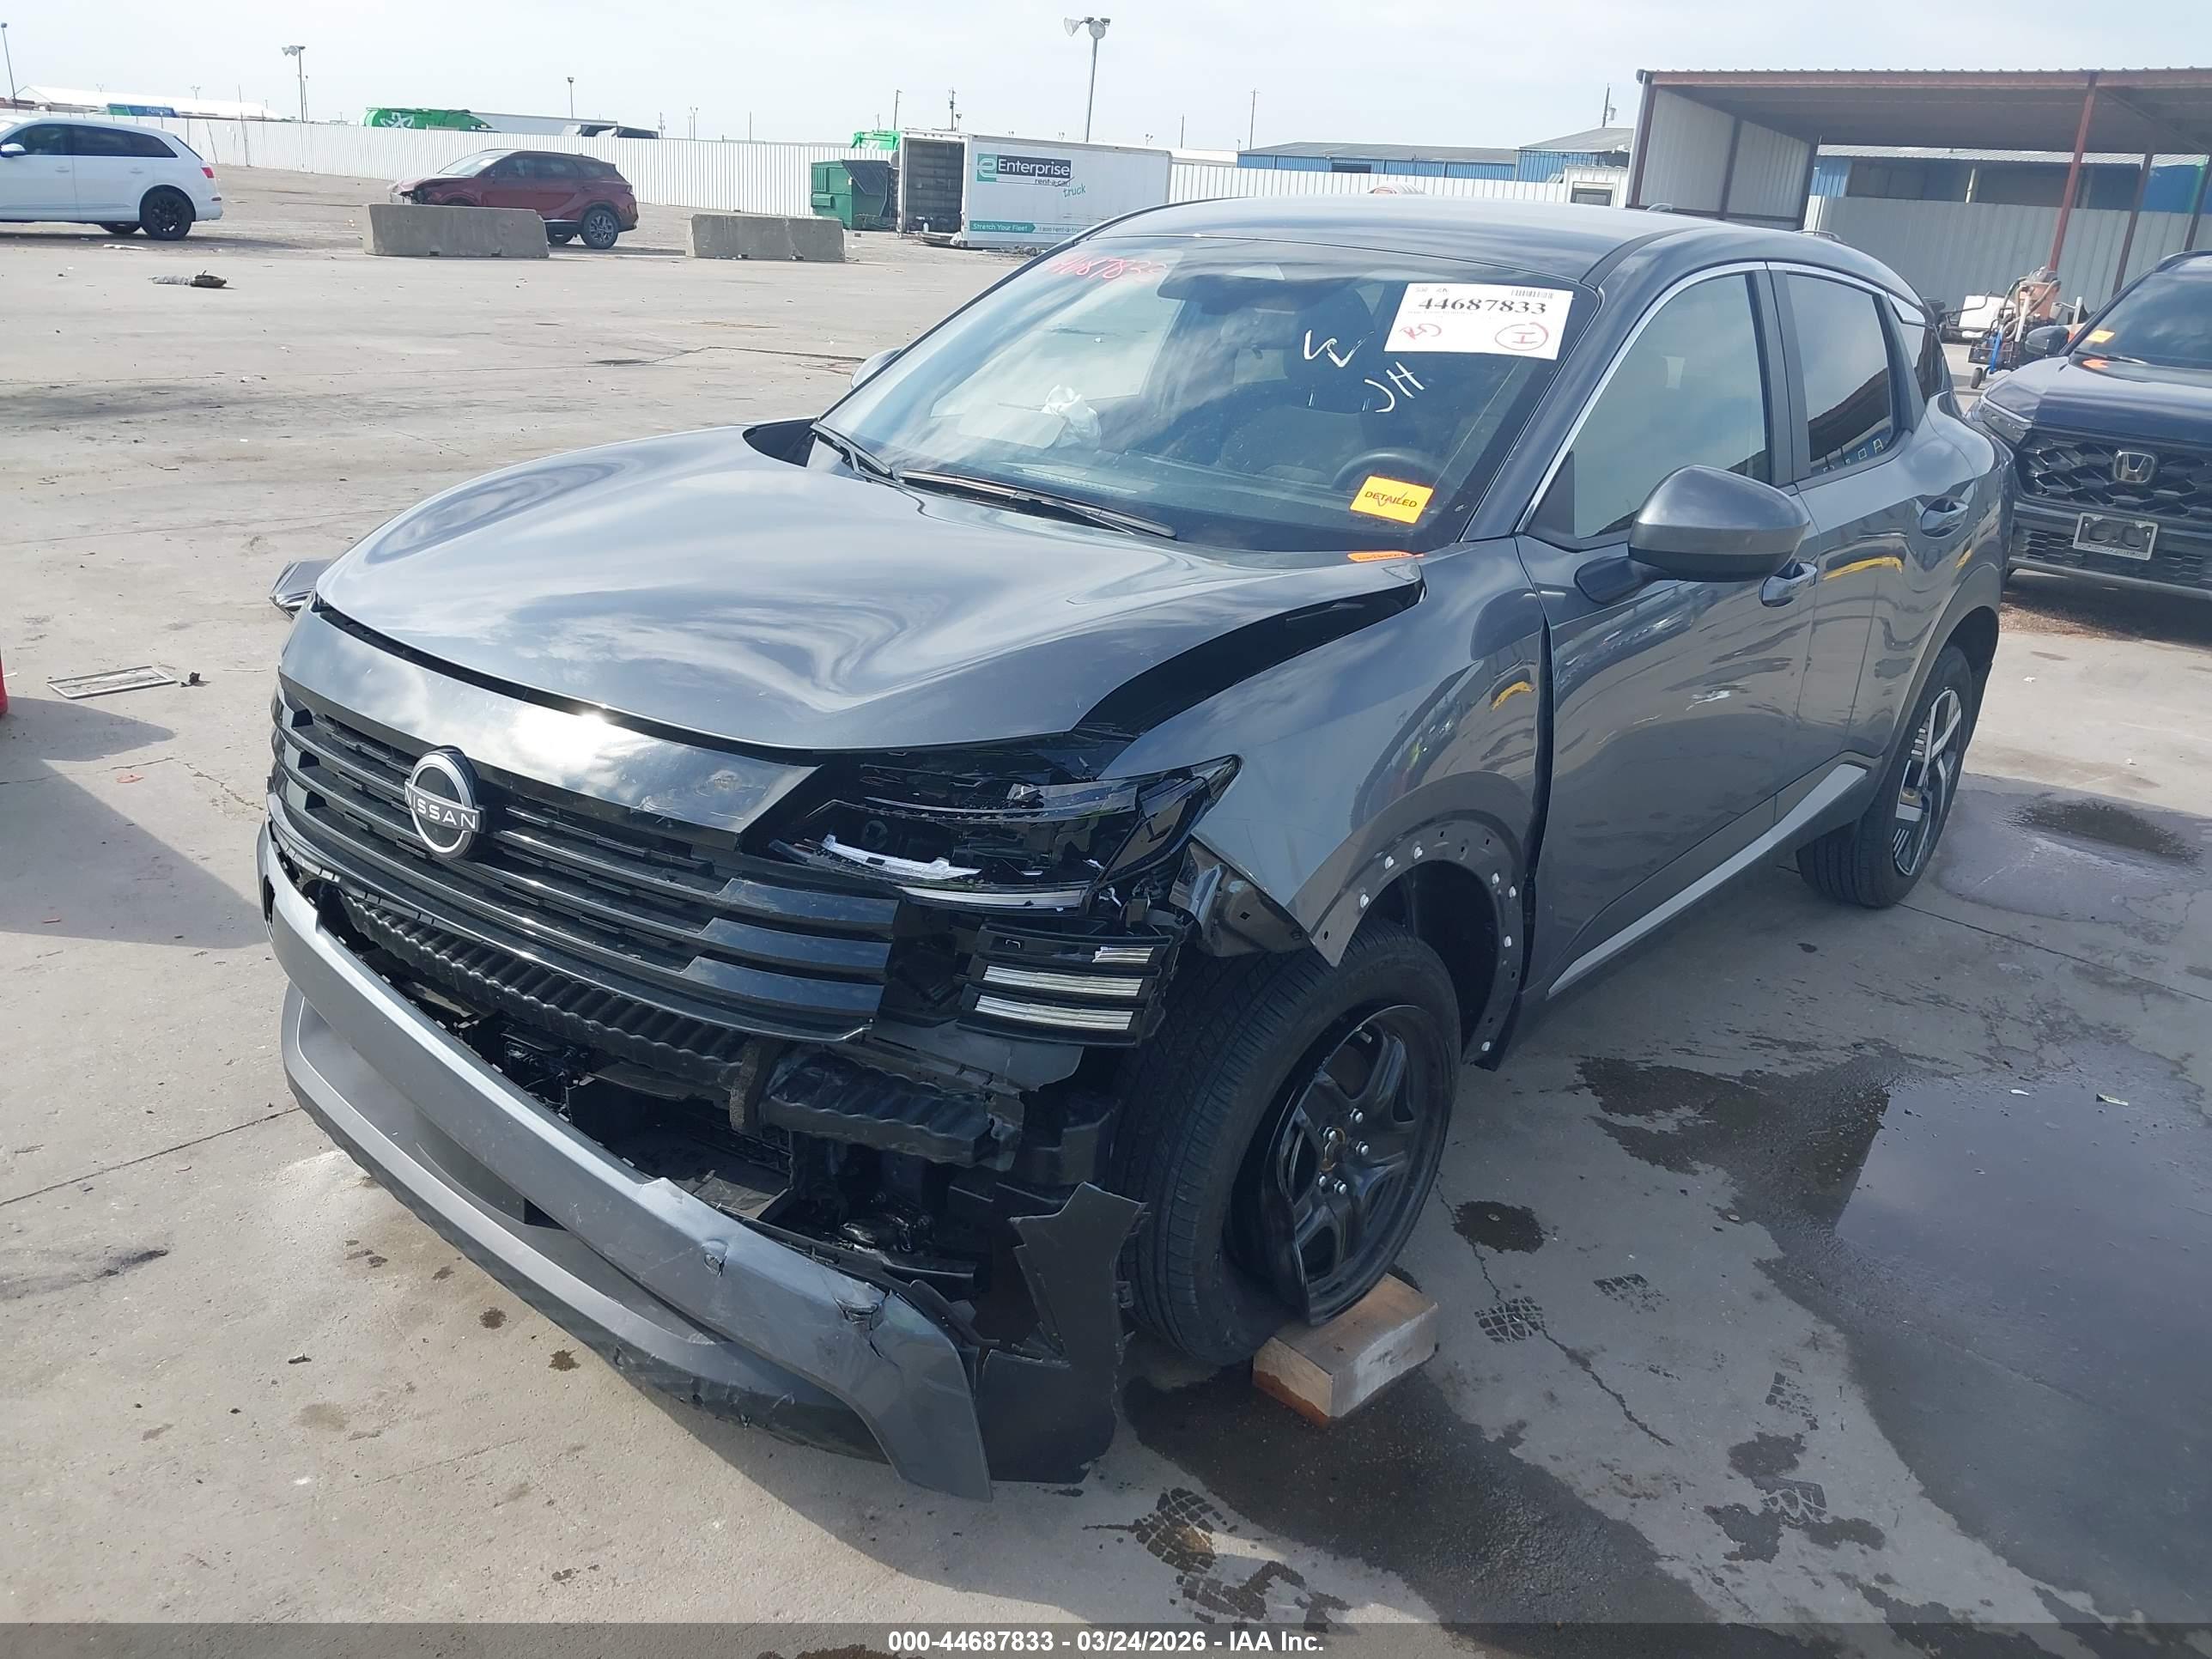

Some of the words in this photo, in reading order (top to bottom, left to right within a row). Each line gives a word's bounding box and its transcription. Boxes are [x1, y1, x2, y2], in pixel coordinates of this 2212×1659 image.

[998, 158, 1070, 178] Enterprise
[1063, 183, 1085, 198] truck
[1419, 298, 1547, 314] 44687833
[1364, 491, 1418, 507] DETAILED
[404, 782, 476, 830] NISSAN
